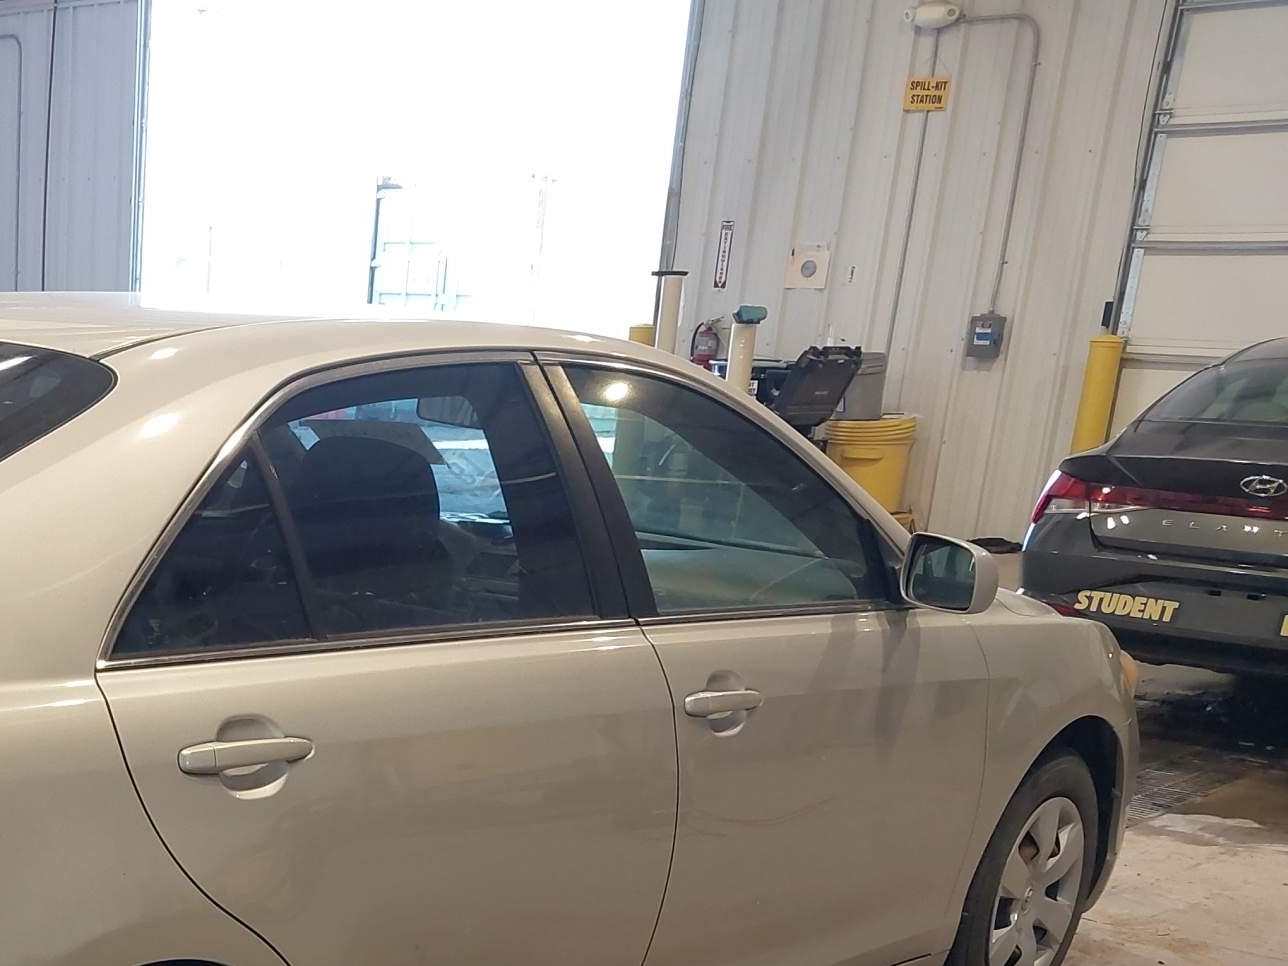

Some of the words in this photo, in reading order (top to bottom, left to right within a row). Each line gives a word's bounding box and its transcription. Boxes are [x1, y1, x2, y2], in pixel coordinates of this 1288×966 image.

[910, 80, 948, 91] SPILL-KIT
[910, 94, 943, 104] STATION
[1074, 589, 1180, 623] STUDENT
